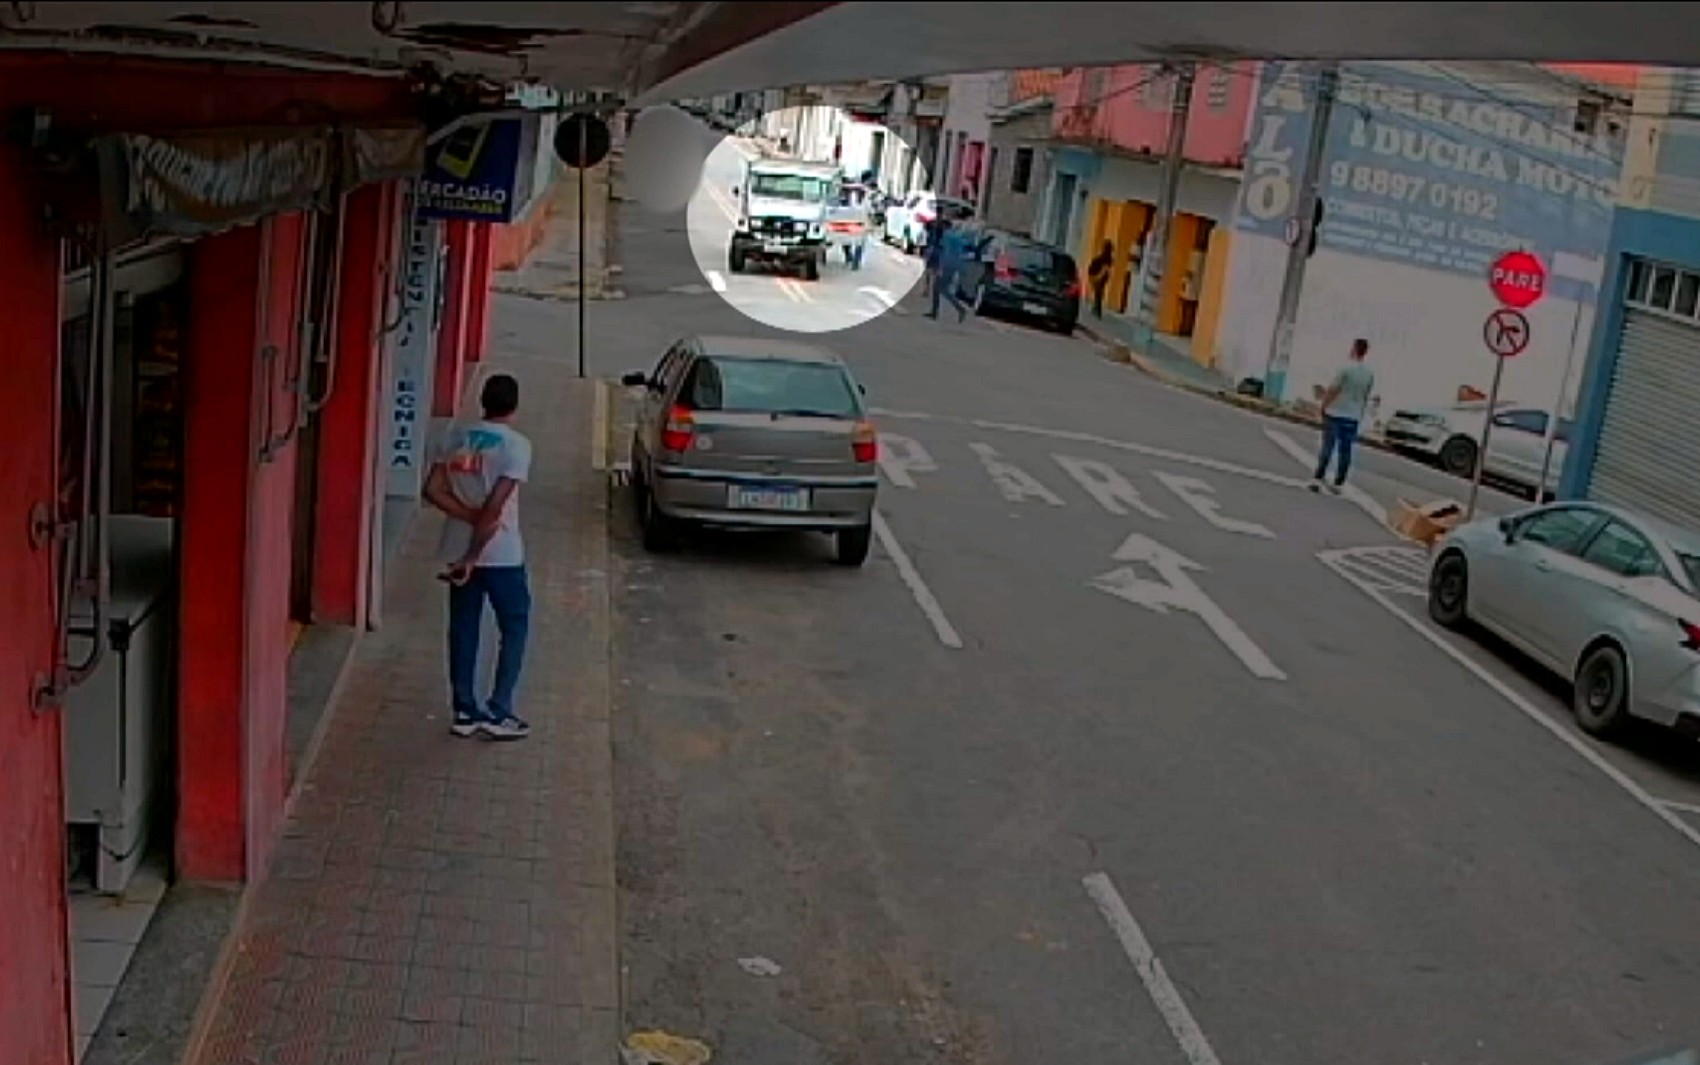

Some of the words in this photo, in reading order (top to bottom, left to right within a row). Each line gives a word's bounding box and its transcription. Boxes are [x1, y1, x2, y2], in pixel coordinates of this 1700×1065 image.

[1373, 123, 1508, 182] DUCHA
[418, 180, 506, 203] ERCADÃO
[1492, 267, 1541, 292] PARE
[876, 432, 1277, 539] PARE
